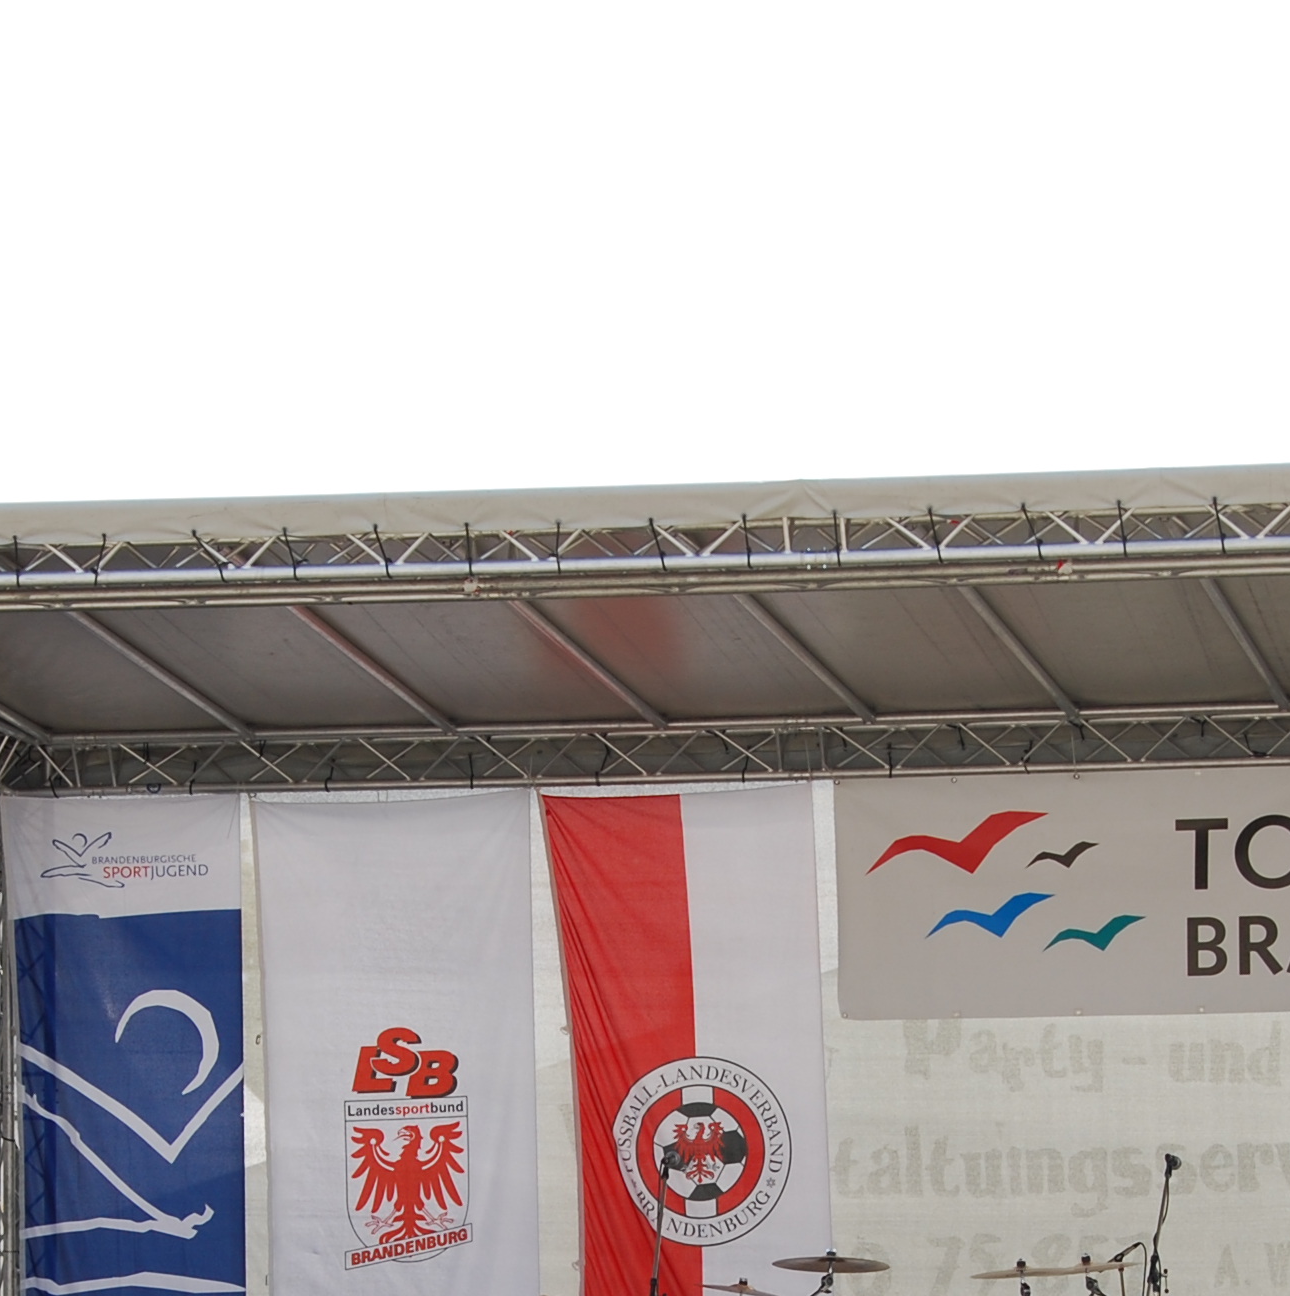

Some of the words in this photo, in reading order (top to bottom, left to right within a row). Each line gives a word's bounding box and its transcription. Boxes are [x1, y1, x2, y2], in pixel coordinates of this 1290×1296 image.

[91, 854, 197, 864] BRANDENBURGISCHE
[103, 864, 209, 880] SPORTJUGEND
[347, 1101, 465, 1118] Landessportbund
[636, 1189, 771, 1238] BRNDENBURG
[350, 1228, 469, 1267] BRANDENBURG
